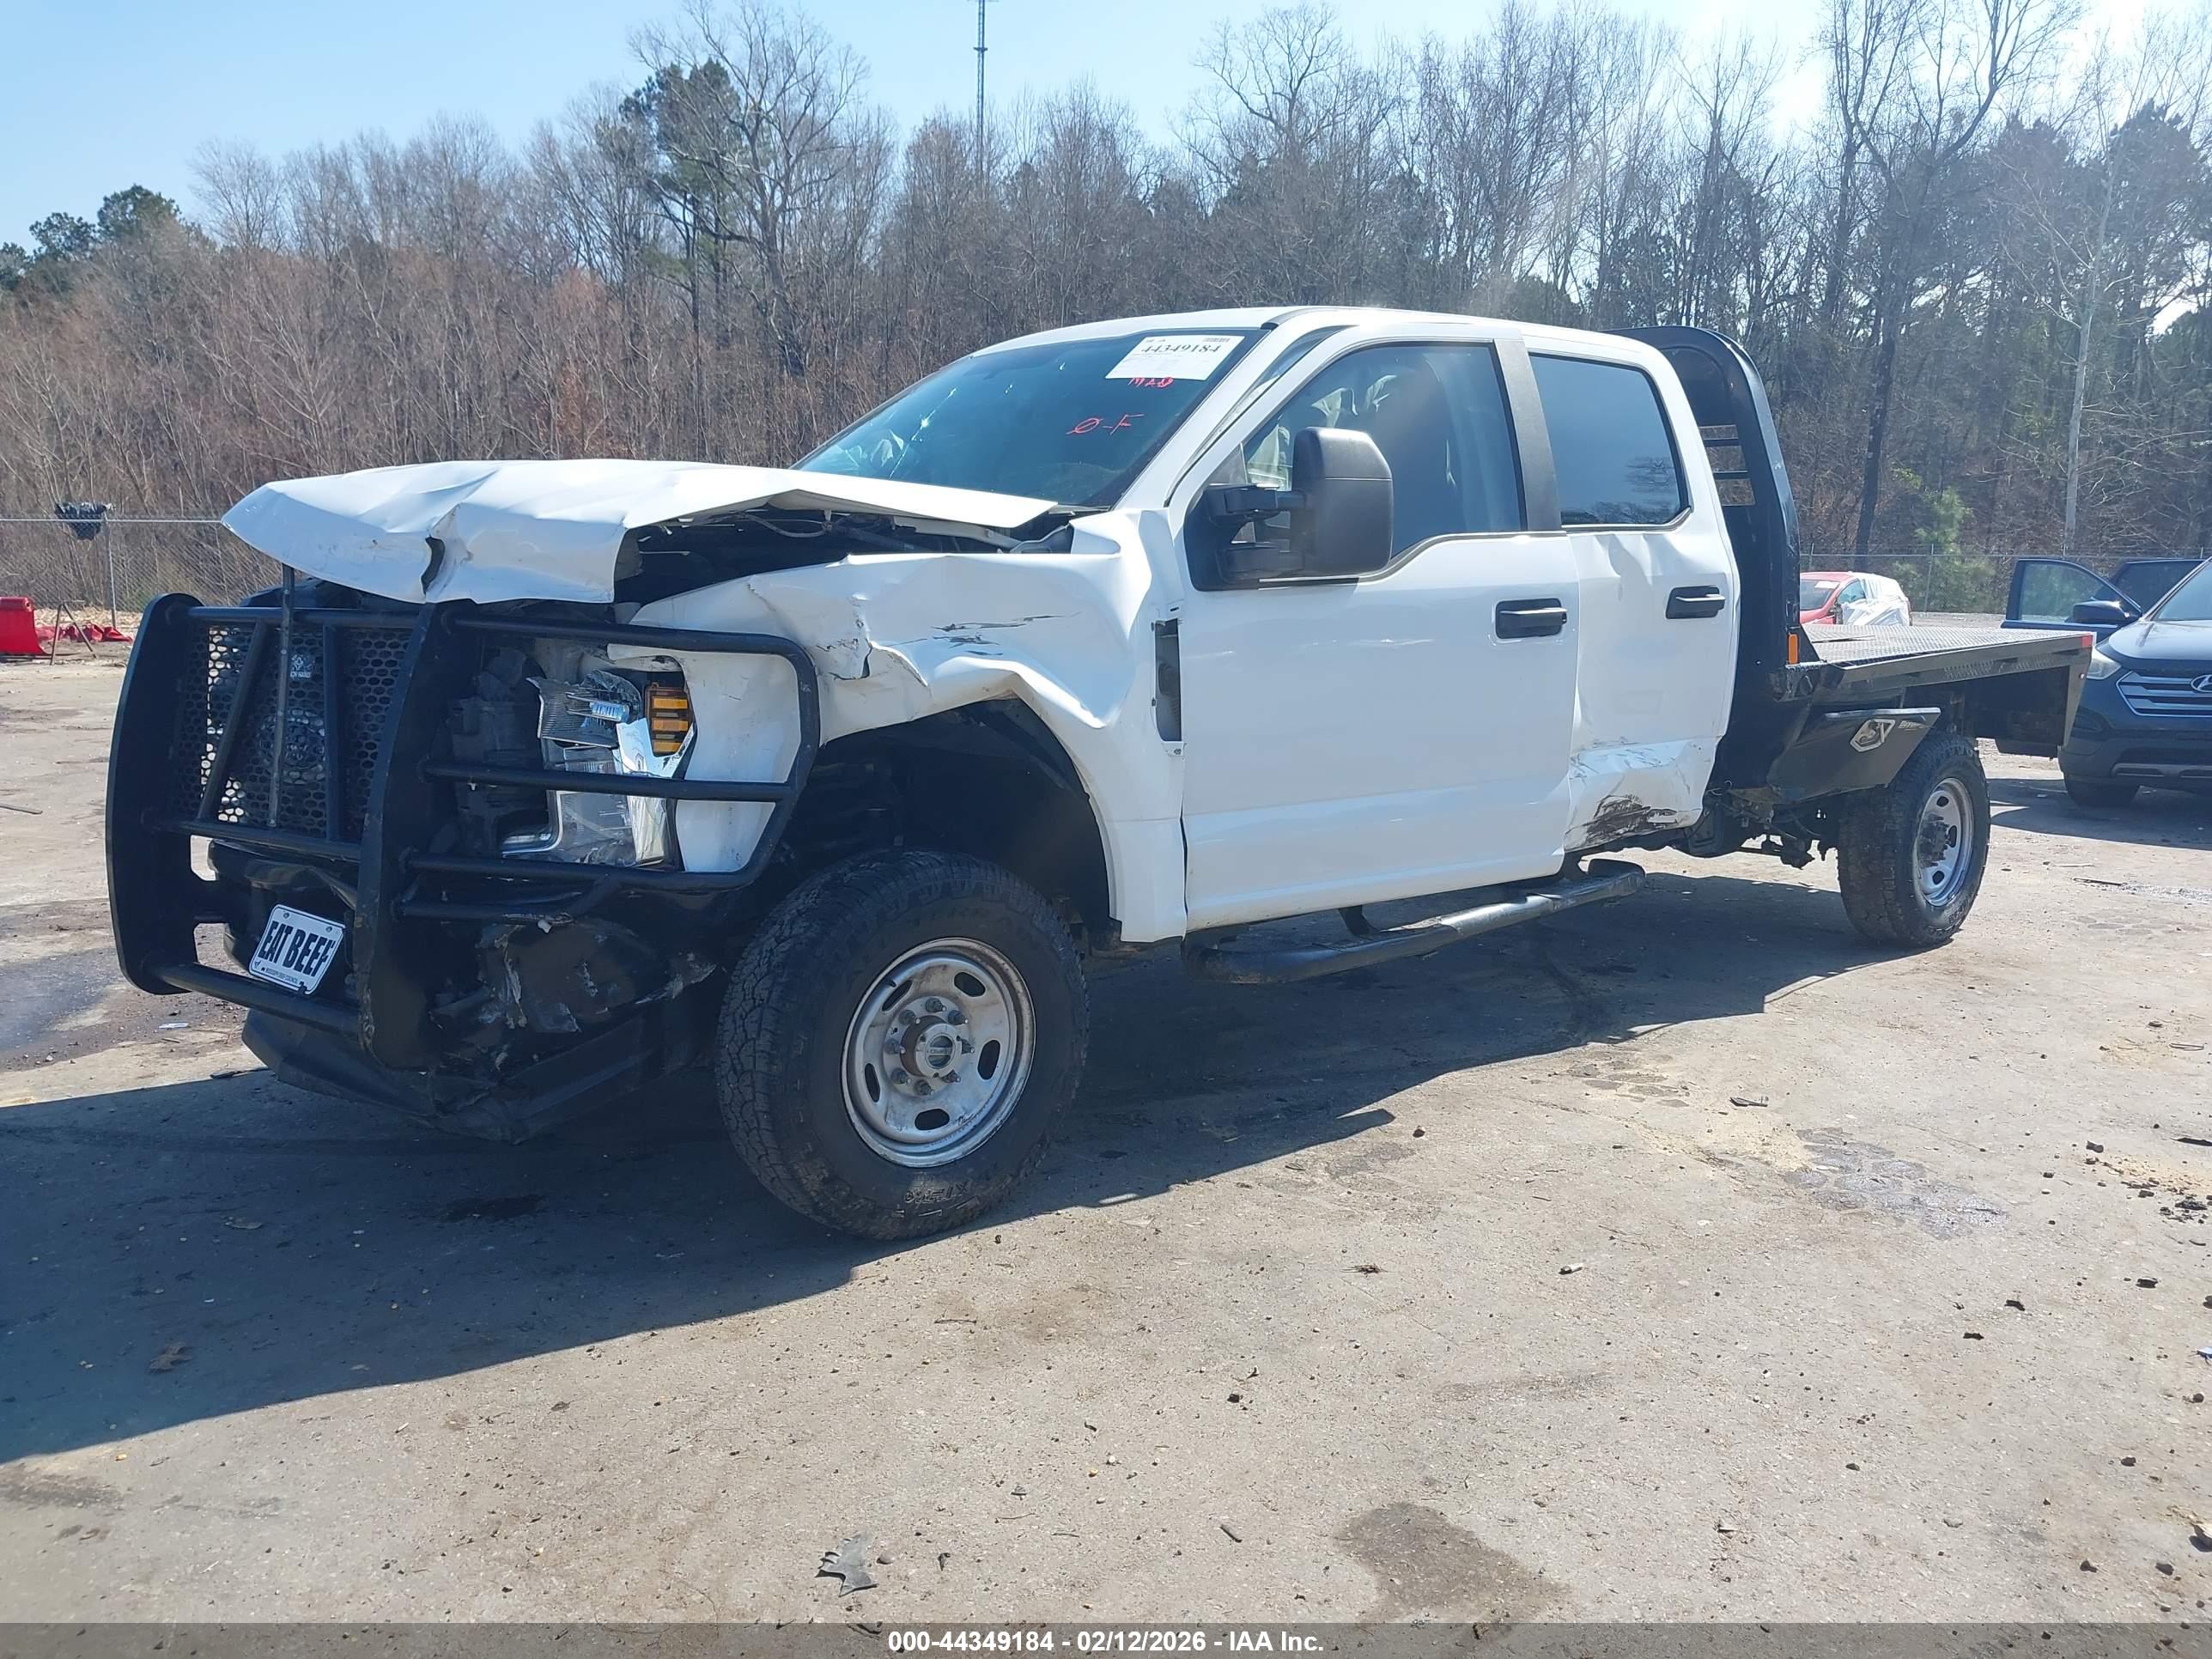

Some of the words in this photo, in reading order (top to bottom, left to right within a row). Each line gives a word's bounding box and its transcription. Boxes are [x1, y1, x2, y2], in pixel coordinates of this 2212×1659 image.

[1140, 344, 1221, 354] 44349184
[258, 920, 294, 964] EAT
[282, 928, 337, 977] BEEF
